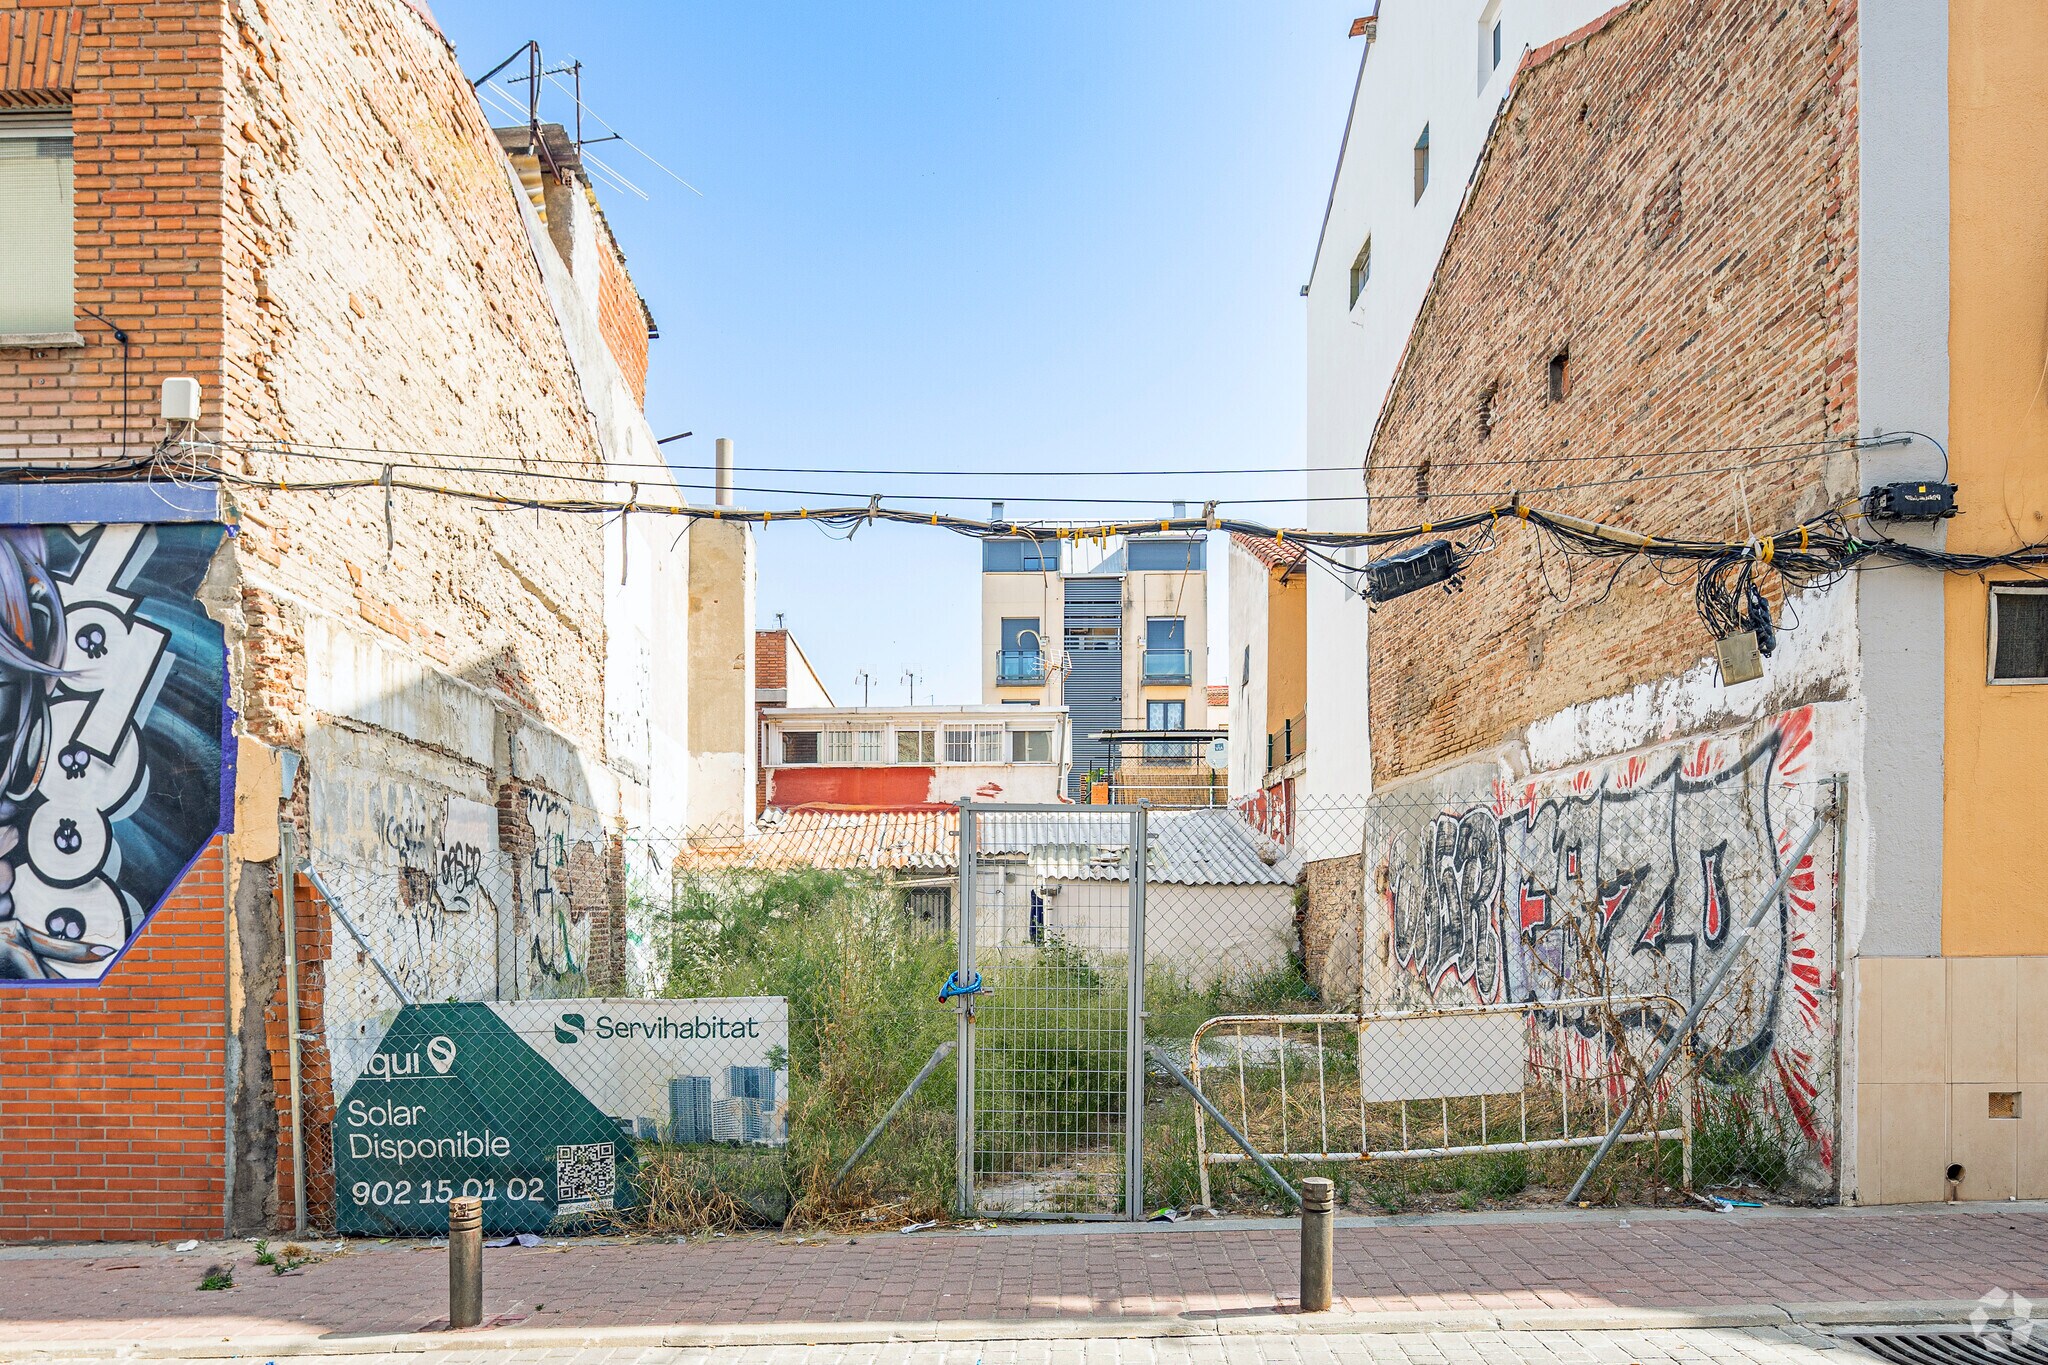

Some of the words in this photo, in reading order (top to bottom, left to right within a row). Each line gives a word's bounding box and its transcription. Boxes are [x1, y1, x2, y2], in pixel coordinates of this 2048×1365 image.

[596, 1016, 760, 1039] Servihabitat
[363, 1043, 420, 1082] quí
[347, 1098, 426, 1127] Solar
[349, 1129, 511, 1165] Disponible
[352, 1180, 412, 1206] 902
[419, 1179, 453, 1204] 15
[462, 1178, 497, 1202] 01
[506, 1177, 545, 1201] 02
